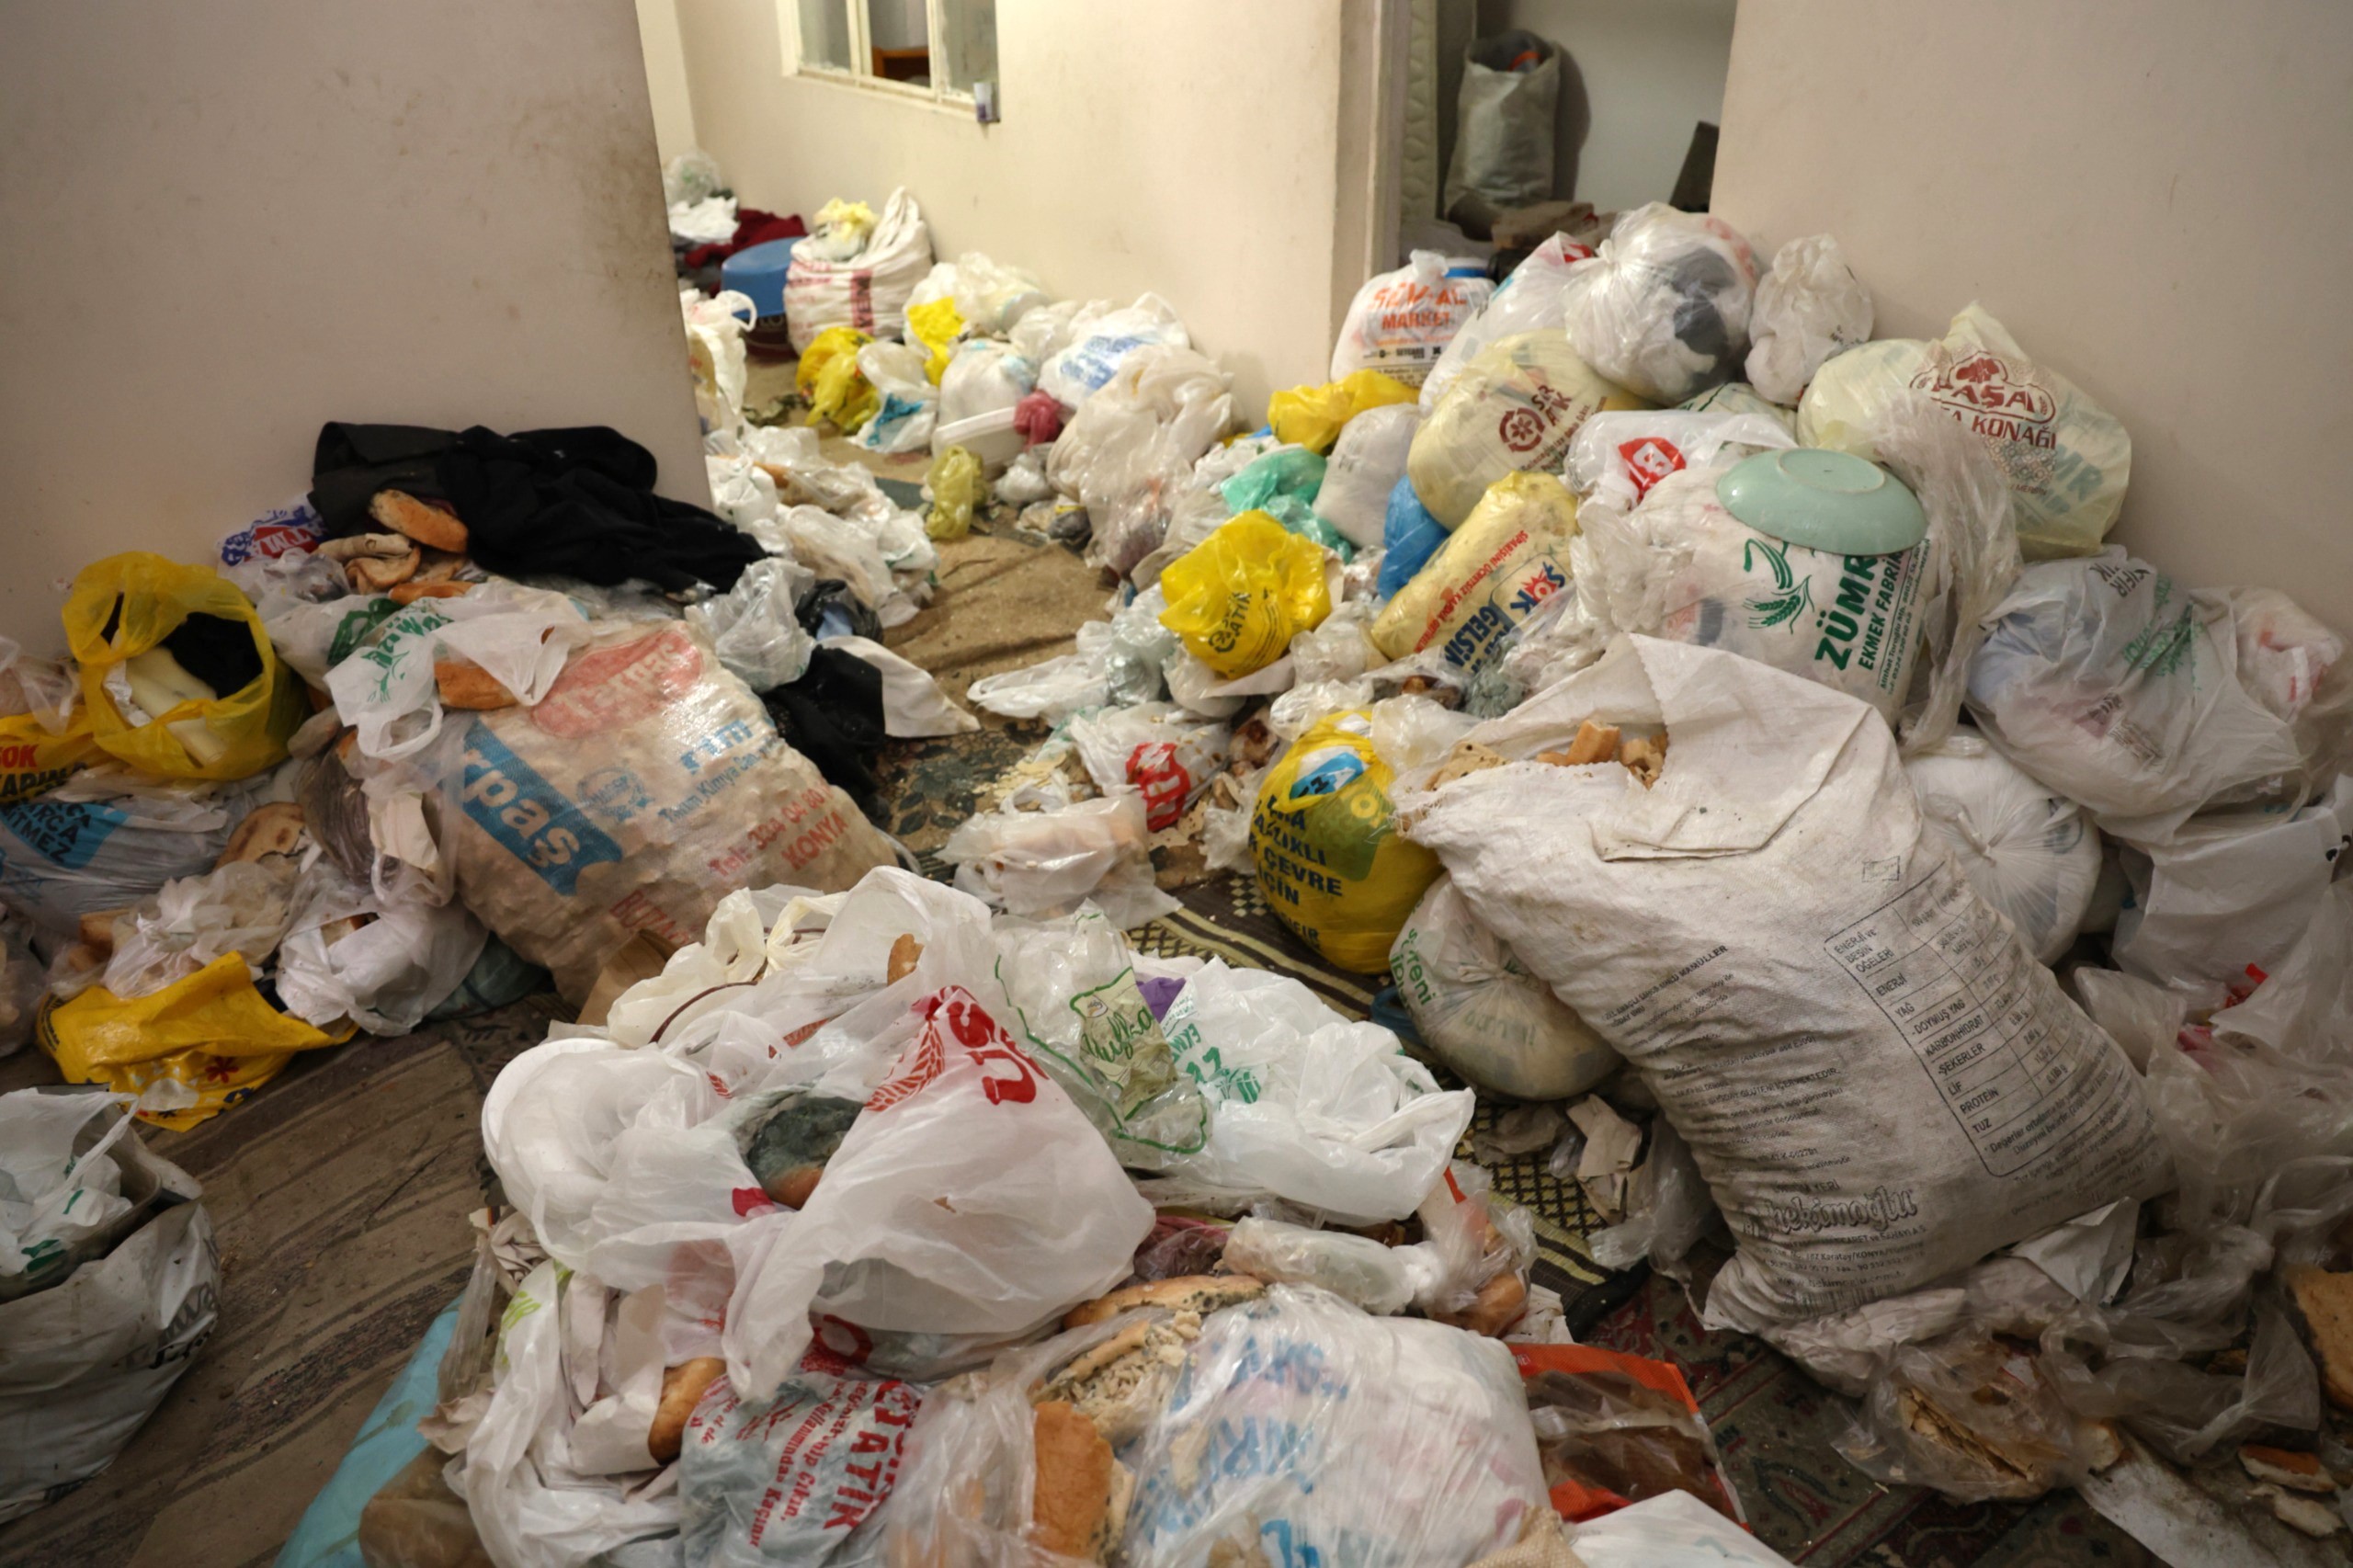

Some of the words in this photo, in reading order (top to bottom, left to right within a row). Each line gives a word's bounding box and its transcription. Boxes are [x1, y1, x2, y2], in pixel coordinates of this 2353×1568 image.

[1382, 311, 1450, 330] MARKET
[1971, 415, 2057, 449] KONAĞI
[1859, 612, 1886, 670] EKMEK
[698, 766, 740, 801] Kimya
[781, 811, 849, 871] KONYA
[1264, 846, 1343, 897] ÇEVRE
[1876, 971, 1907, 997] ENERJİ
[1894, 1001, 1915, 1018] YAĞ
[1923, 1014, 1985, 1057] KARBONHİDRAT
[1948, 1079, 1963, 1096] LİF
[1960, 1085, 2000, 1115] PROTEİN
[1972, 1117, 1994, 1134] TUZ
[823, 1429, 891, 1529] ATIK
